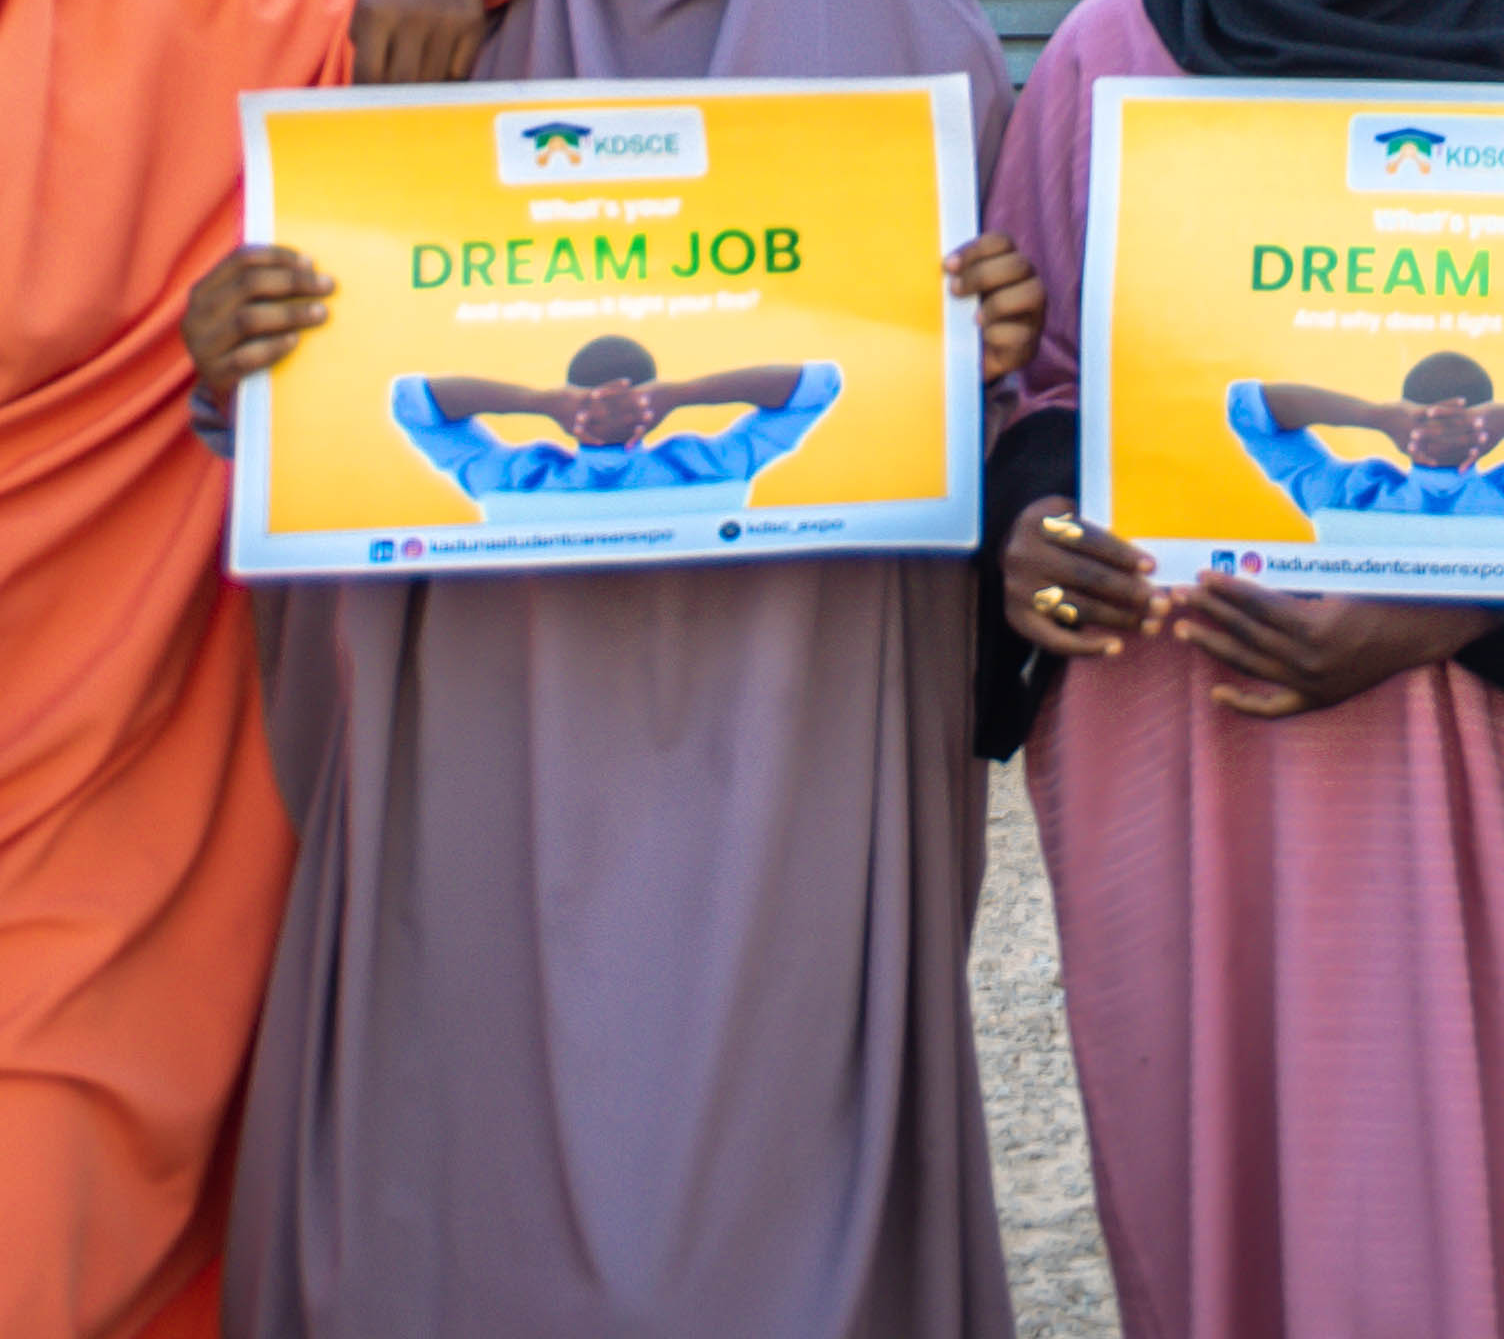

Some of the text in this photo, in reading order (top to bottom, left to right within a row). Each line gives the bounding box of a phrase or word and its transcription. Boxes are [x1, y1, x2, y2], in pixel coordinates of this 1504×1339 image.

[594, 133, 680, 156] KDSCE
[623, 197, 682, 223] your
[412, 227, 802, 289] DREAM JOB
[1251, 243, 1490, 298] DREAM
